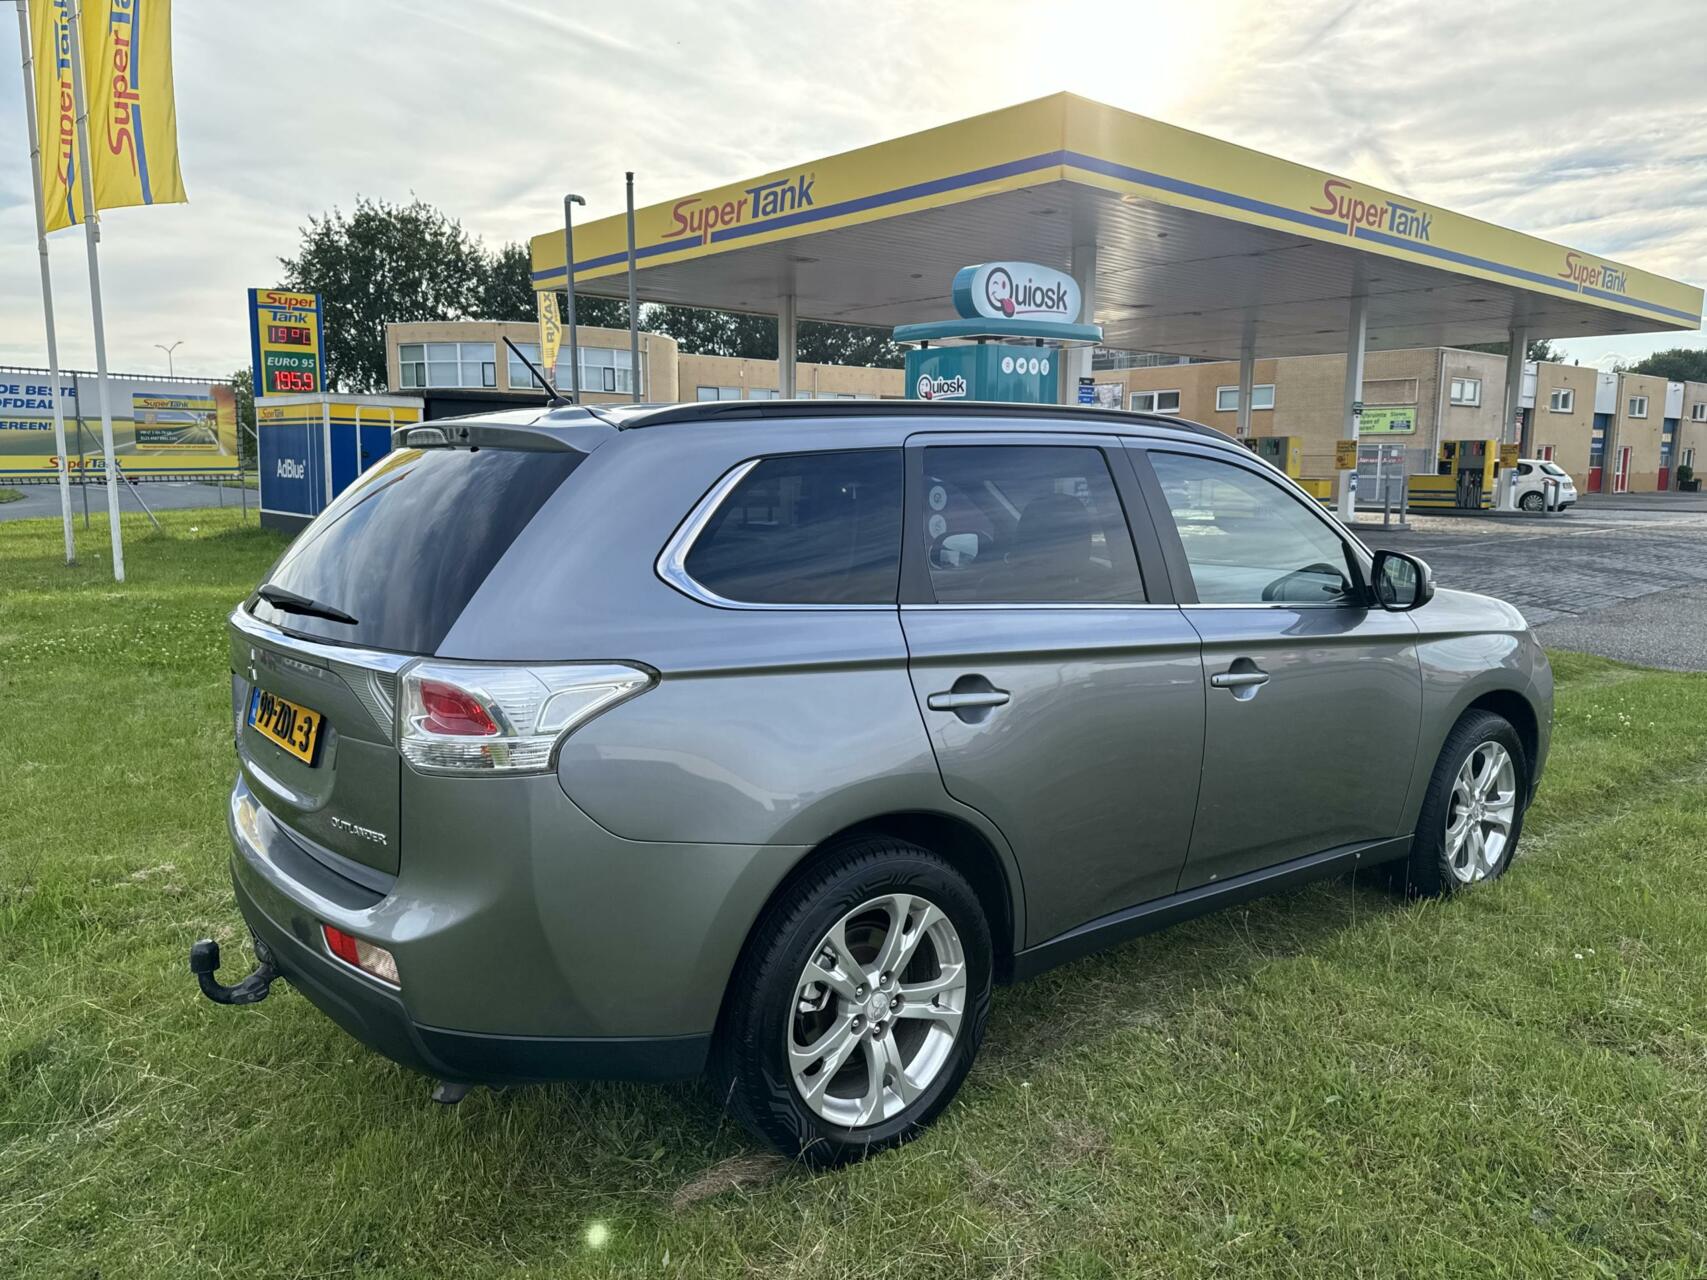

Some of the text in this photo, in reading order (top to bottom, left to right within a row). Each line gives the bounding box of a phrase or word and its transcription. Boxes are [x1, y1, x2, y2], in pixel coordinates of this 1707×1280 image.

[661, 175, 815, 245] SuperTank
[1310, 179, 1432, 241] SuperTank
[1558, 252, 1628, 294] SuperTank
[259, 292, 315, 311] Super
[985, 267, 1068, 318] Quiosk
[268, 311, 308, 324] Tank
[267, 357, 315, 368] EURO 95
[917, 376, 965, 400] Quiosk
[43, 456, 122, 473] SperTak
[276, 458, 305, 480] AdBlue
[257, 691, 313, 753] 99-ZDL-3
[331, 816, 388, 846] OUTLANDER
